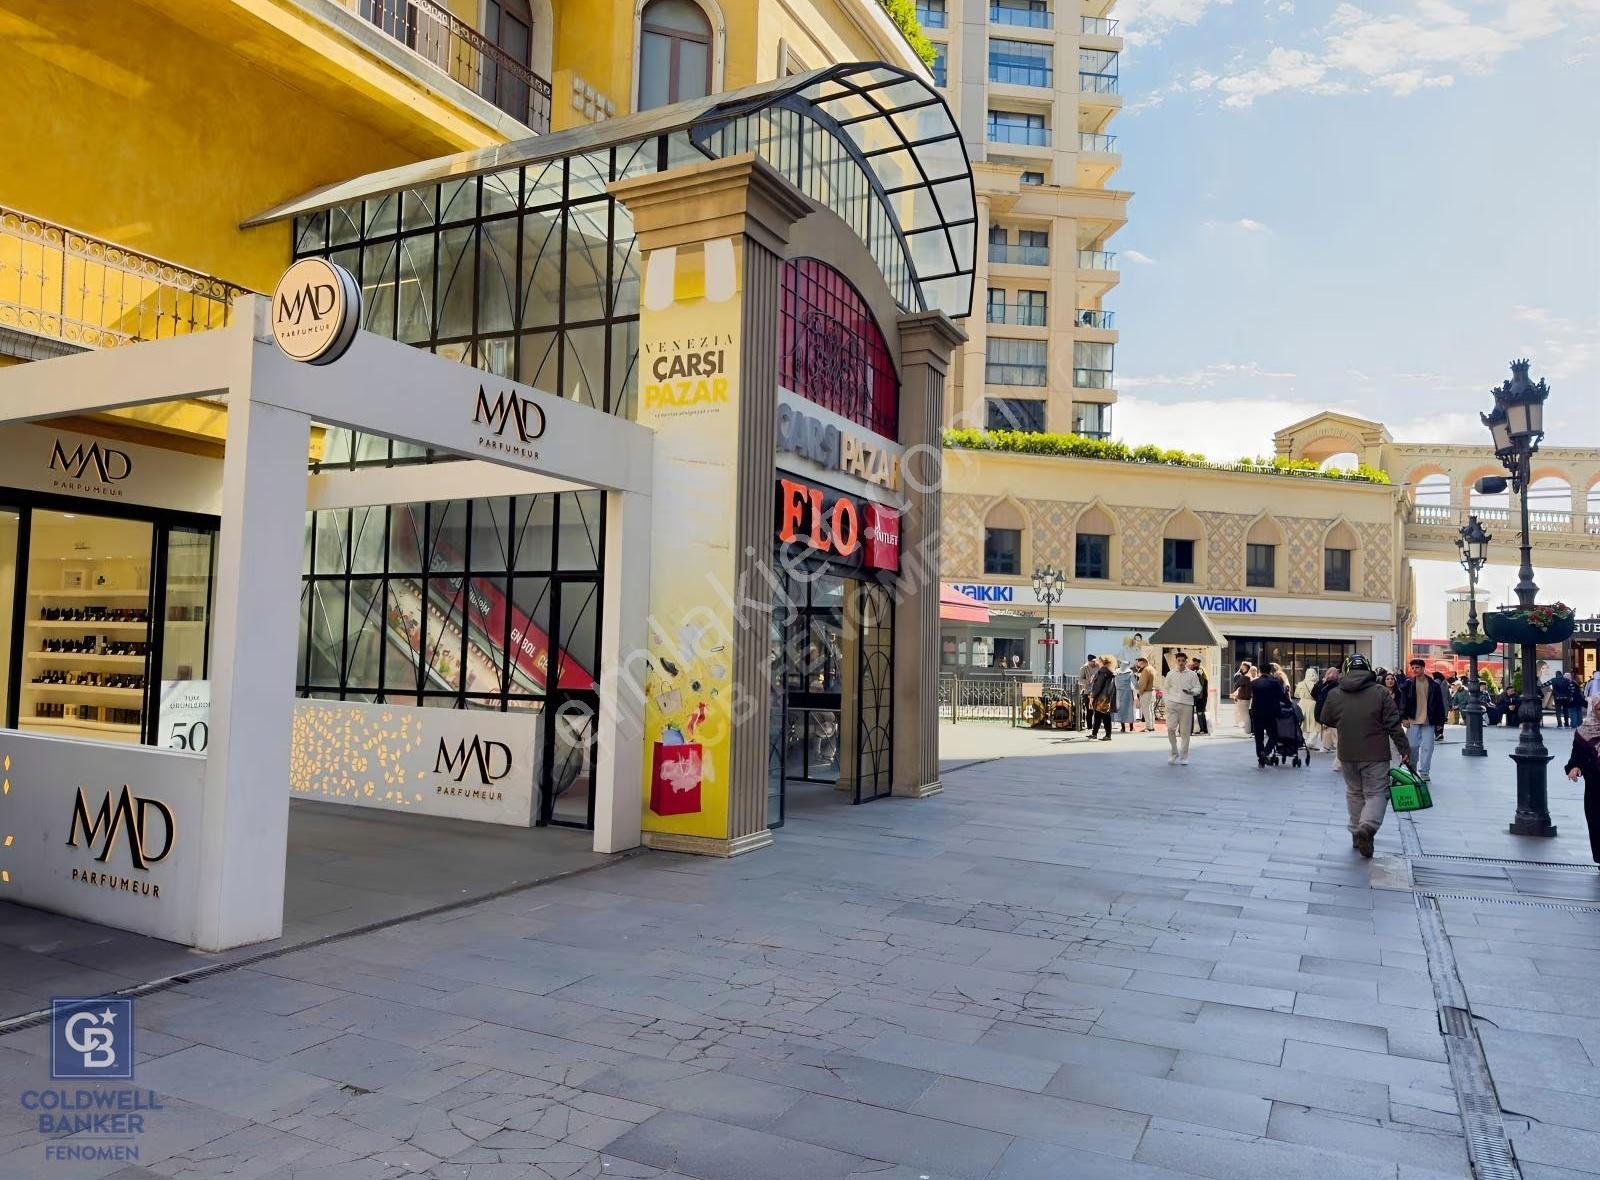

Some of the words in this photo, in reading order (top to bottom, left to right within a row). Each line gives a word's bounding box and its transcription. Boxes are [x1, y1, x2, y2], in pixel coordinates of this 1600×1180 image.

[276, 282, 336, 326] MAD
[281, 324, 330, 338] PARFUMEUR
[645, 334, 732, 353] VENEZIA
[652, 350, 724, 383] ÇARŞI
[645, 378, 729, 409] PAZAR
[472, 384, 546, 443] MAD
[48, 438, 132, 484] MAD
[479, 437, 540, 460] PARFUMEUR
[53, 481, 124, 497] PARFUMEUR
[779, 478, 858, 557] FLO
[520, 637, 536, 658] BOL
[169, 721, 209, 752] 50
[432, 734, 513, 785] MAD
[436, 786, 502, 801] PARFUMEUR
[65, 783, 176, 871] MAD
[72, 868, 161, 899] PARFUMEUR
